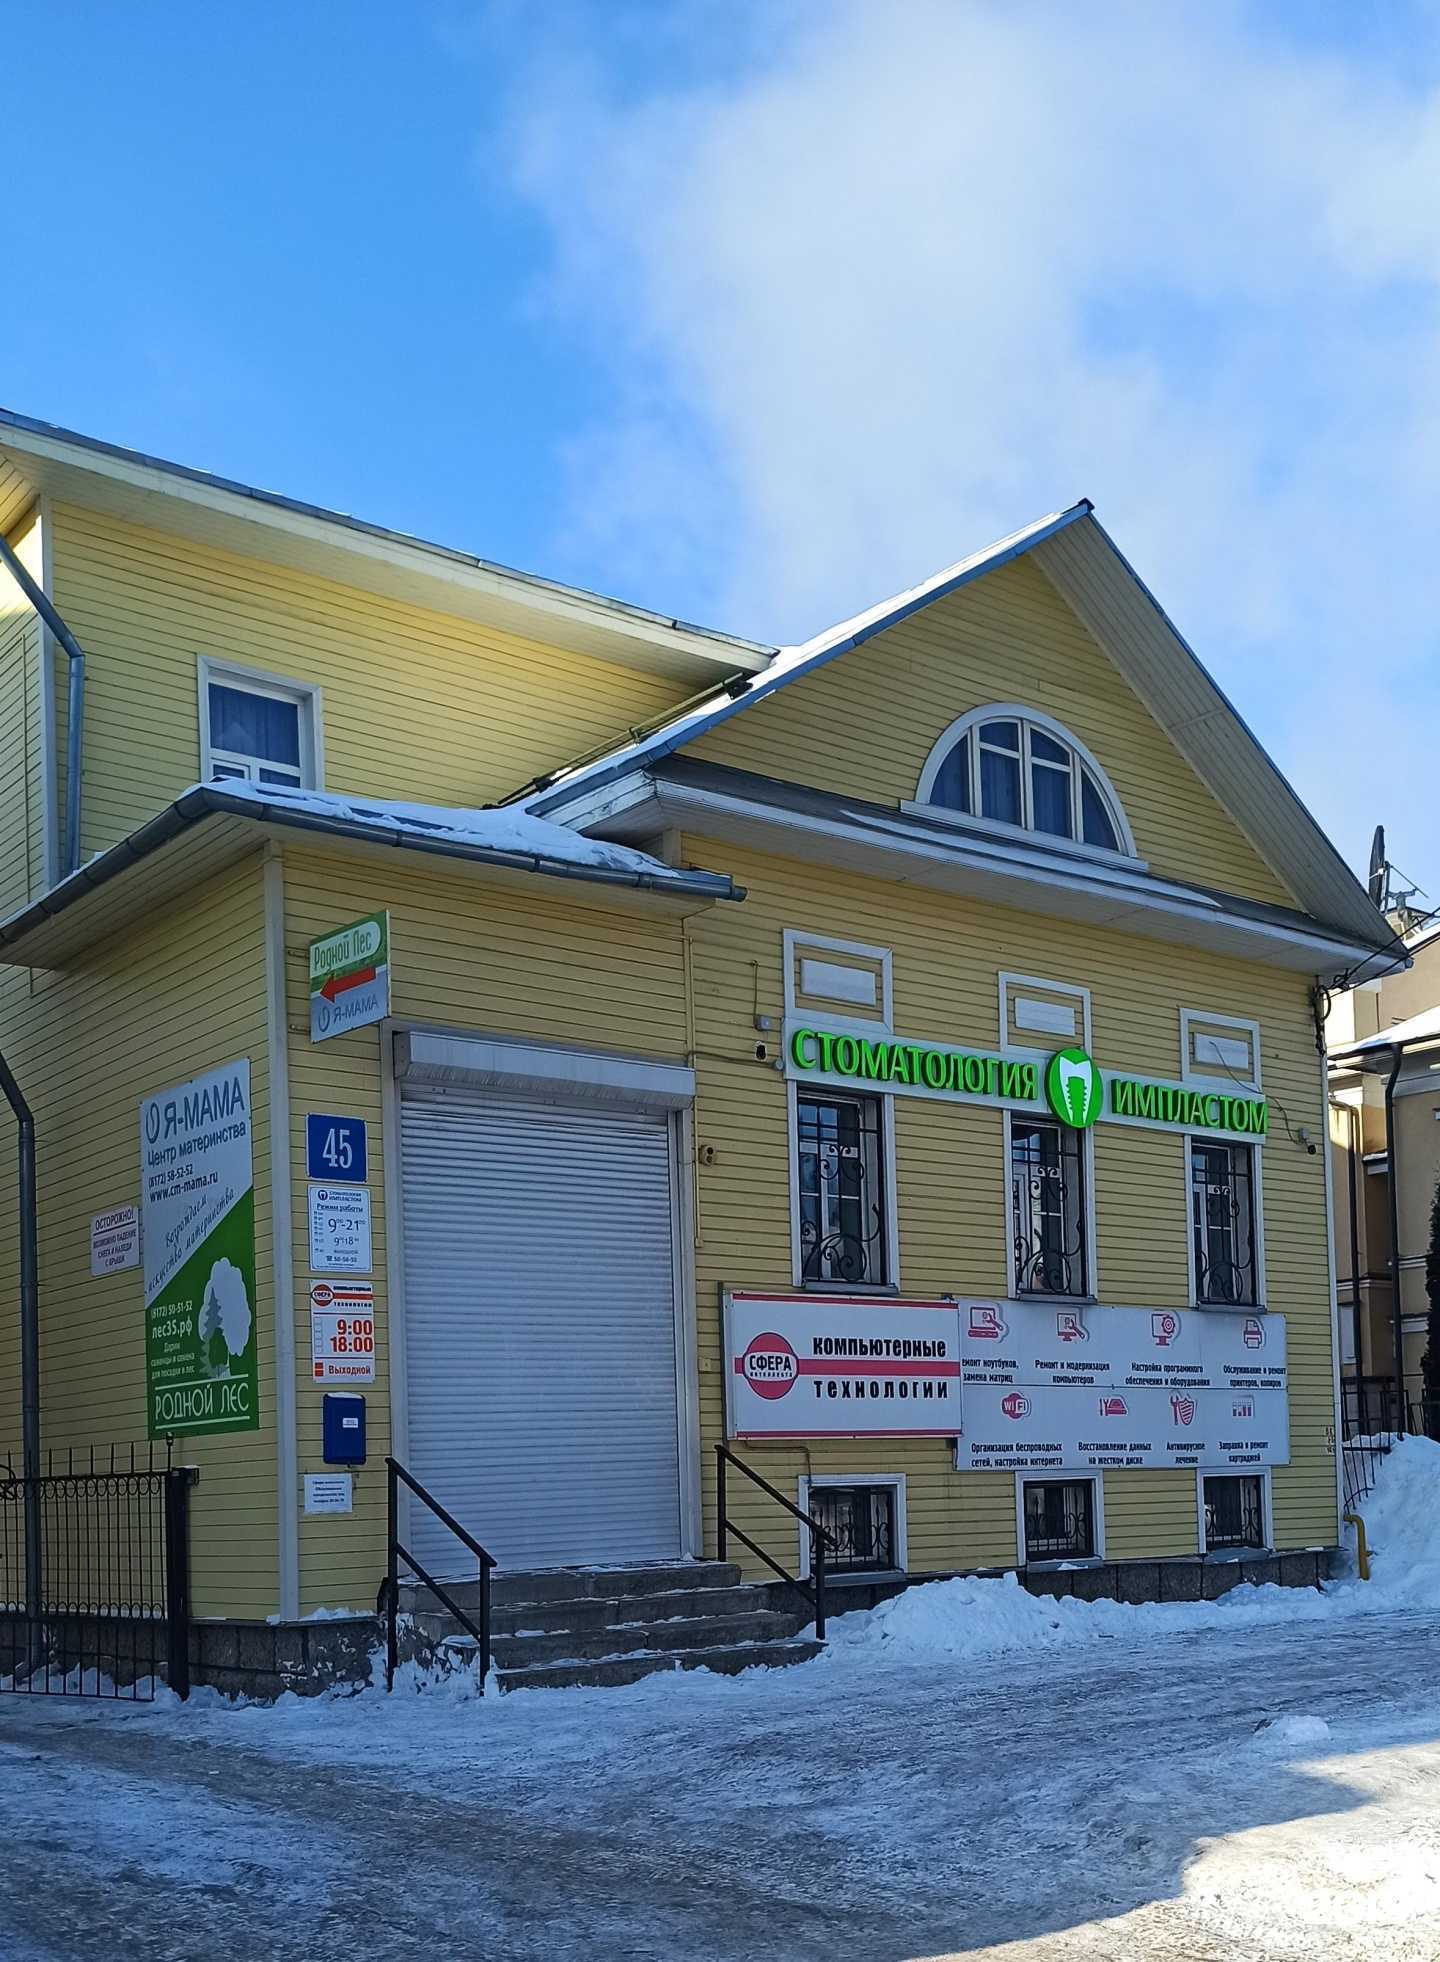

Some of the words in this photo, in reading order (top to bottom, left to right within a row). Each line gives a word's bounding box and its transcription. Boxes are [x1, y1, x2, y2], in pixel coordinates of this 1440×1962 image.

[314, 935, 350, 973] Родной
[334, 994, 379, 1025] Я-МАМА
[791, 1028, 1038, 1100] СТОМАТОЛОГИЯ
[1110, 1078, 1268, 1134] ИМПЛАСТОМ
[163, 1077, 246, 1140] Я-МАМА
[147, 1148, 177, 1167] Центр
[178, 1121, 247, 1157] материнства
[322, 1128, 353, 1169] 45
[167, 1163, 193, 1182] 58-52-52
[149, 1172, 219, 1202] www.cm-mama.ru
[152, 1314, 193, 1339] лес35.рф
[337, 1319, 373, 1335] 9:00
[330, 1336, 373, 1353] 18:00
[813, 1336, 946, 1360] компьютерные
[328, 1365, 371, 1377] Выходной
[749, 1354, 792, 1371] СФЕРА
[961, 1358, 982, 1367] емонт
[1035, 1359, 1058, 1369] Ремонт
[1131, 1362, 1162, 1373] Настройка
[963, 1373, 987, 1382] замена
[989, 1374, 1014, 1383] матриц
[1052, 1375, 1095, 1385] компьютеров
[1125, 1376, 1163, 1386] обеспечения
[813, 1380, 947, 1399] технологии
[155, 1383, 214, 1421] РОДНОЙ
[220, 1382, 249, 1413] ЛЕС
[971, 1442, 1014, 1454] Организация
[1015, 1442, 1063, 1453] беспроводных
[1078, 1441, 1128, 1452] Восстановление
[1128, 1443, 1152, 1453] данных
[971, 1457, 993, 1468] сетей,
[994, 1457, 1028, 1468] настройка
[1030, 1457, 1063, 1467] интернета
[1088, 1456, 1097, 1465] на
[1097, 1456, 1124, 1465] жестком
[1125, 1456, 1144, 1465] диске
